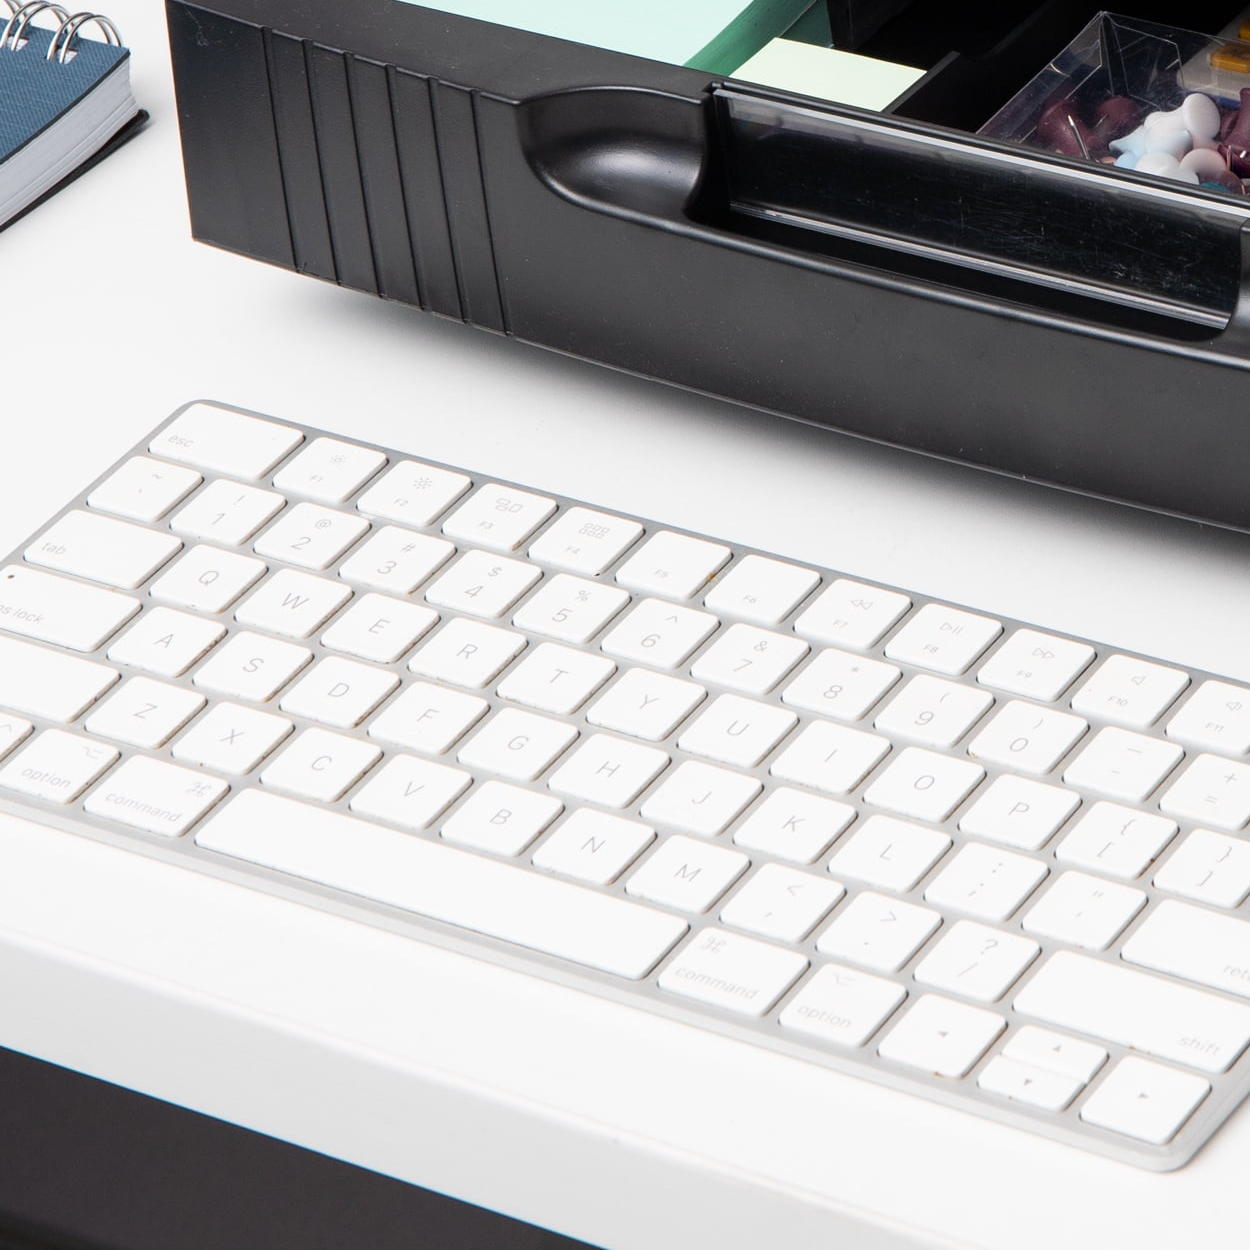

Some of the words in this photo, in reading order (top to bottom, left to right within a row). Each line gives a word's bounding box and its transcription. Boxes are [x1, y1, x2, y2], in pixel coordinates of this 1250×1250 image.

[168, 435, 194, 447] esc
[309, 474, 324, 483] F1
[233, 495, 245, 505] !
[394, 498, 408, 506] F2
[212, 513, 226, 525] 1
[315, 519, 332, 530] @
[479, 521, 494, 530] F3
[42, 542, 66, 554] tab
[291, 537, 311, 550] 2
[401, 543, 416, 553] #
[565, 546, 580, 554] F4
[377, 561, 397, 574] 3
[488, 567, 502, 577] $
[654, 569, 669, 578] F5
[199, 571, 219, 586] Q
[465, 586, 483, 598] 4
[576, 590, 591, 602] %
[743, 595, 757, 603] F6
[282, 593, 309, 609] W
[13, 606, 46, 625] lock
[552, 608, 572, 622] 5
[368, 619, 390, 634] E
[833, 620, 848, 628] F7
[154, 634, 173, 648] A
[641, 634, 661, 647] 6
[754, 641, 768, 652] &
[456, 644, 478, 659] R
[923, 644, 939, 653] F8
[243, 658, 264, 672] S
[733, 659, 752, 671] 7
[550, 669, 568, 683] T
[1017, 670, 1032, 678] F9
[328, 682, 350, 697] D
[823, 685, 843, 699] 8
[640, 694, 658, 709] Y
[1107, 696, 1128, 707] F10
[133, 703, 157, 718] Z
[417, 709, 438, 721] F
[915, 711, 934, 725] 9
[727, 720, 749, 736] U
[1205, 722, 1224, 732] F11
[220, 729, 244, 745] X
[508, 736, 529, 750] G
[1009, 738, 1029, 752] 0
[311, 756, 332, 771] C
[596, 761, 621, 777] H
[21, 768, 72, 791] option
[914, 775, 935, 790] O
[1224, 774, 1237, 782] +
[404, 782, 424, 796] V
[692, 791, 712, 804] J
[104, 792, 183, 824] command
[1008, 802, 1030, 815] P
[490, 809, 512, 824] B
[782, 815, 804, 832] K
[581, 836, 605, 853] N
[880, 844, 892, 860] L
[674, 864, 702, 882] M
[787, 885, 803, 896] <
[880, 911, 896, 922] >
[981, 939, 998, 955] ?
[674, 967, 760, 1001] command
[797, 1005, 853, 1030] option
[1179, 1038, 1220, 1055] shift
